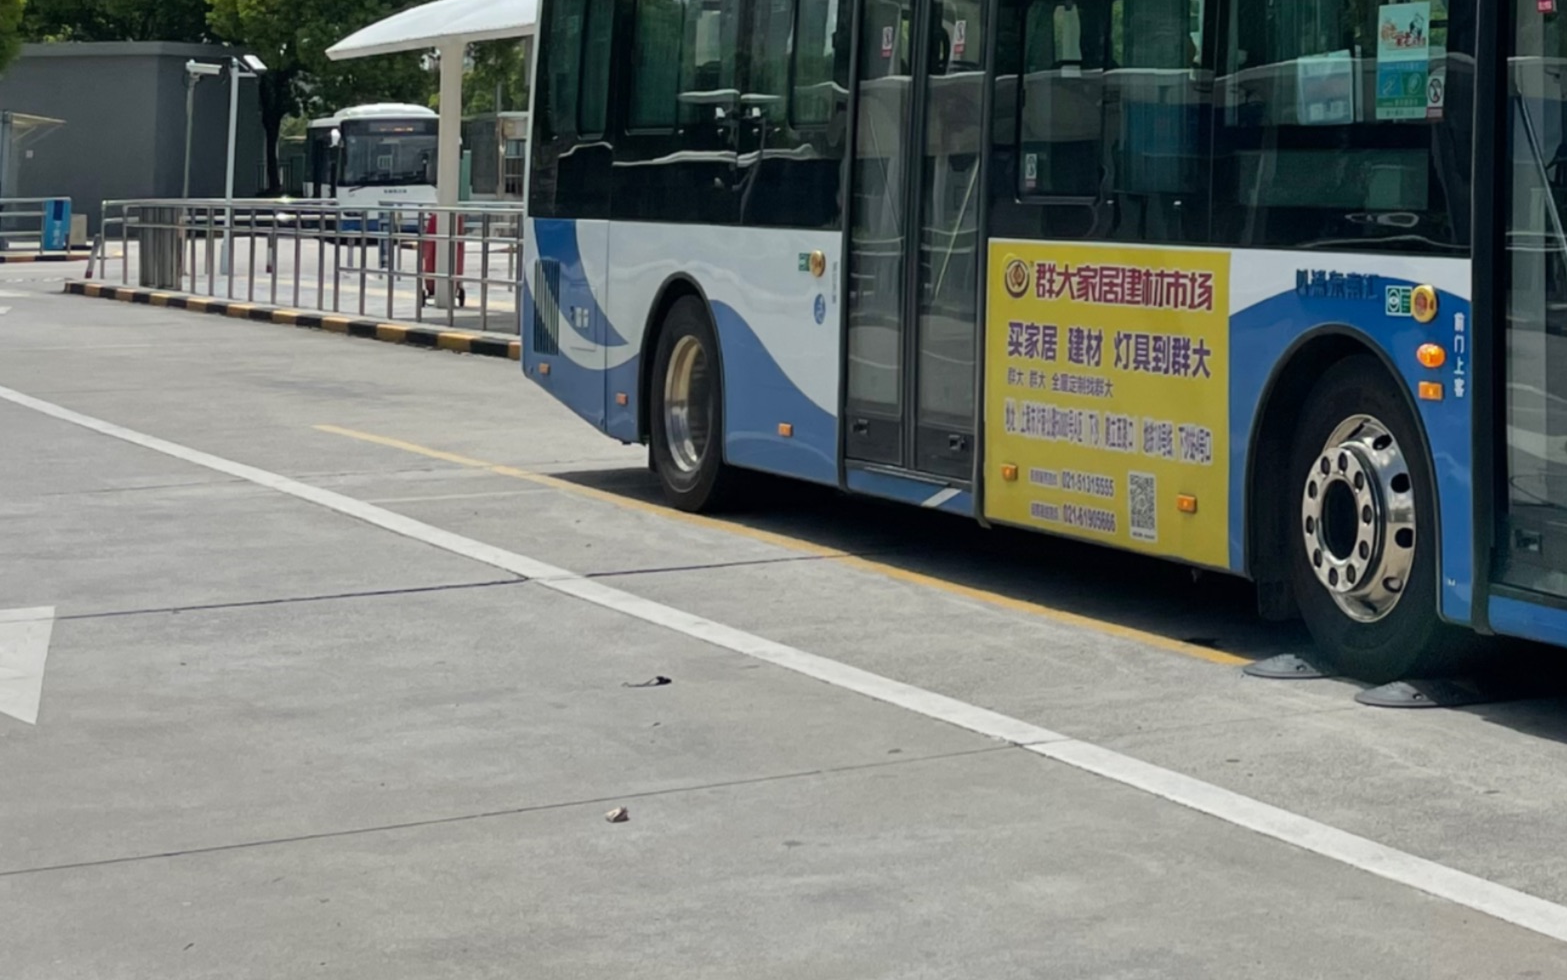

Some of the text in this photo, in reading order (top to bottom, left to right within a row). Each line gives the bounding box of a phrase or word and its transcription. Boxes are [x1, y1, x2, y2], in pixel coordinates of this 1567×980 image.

[1035, 262, 1213, 311] 群大家居建材市场
[1007, 320, 1212, 379] 买家居 建材 灯具到群大
